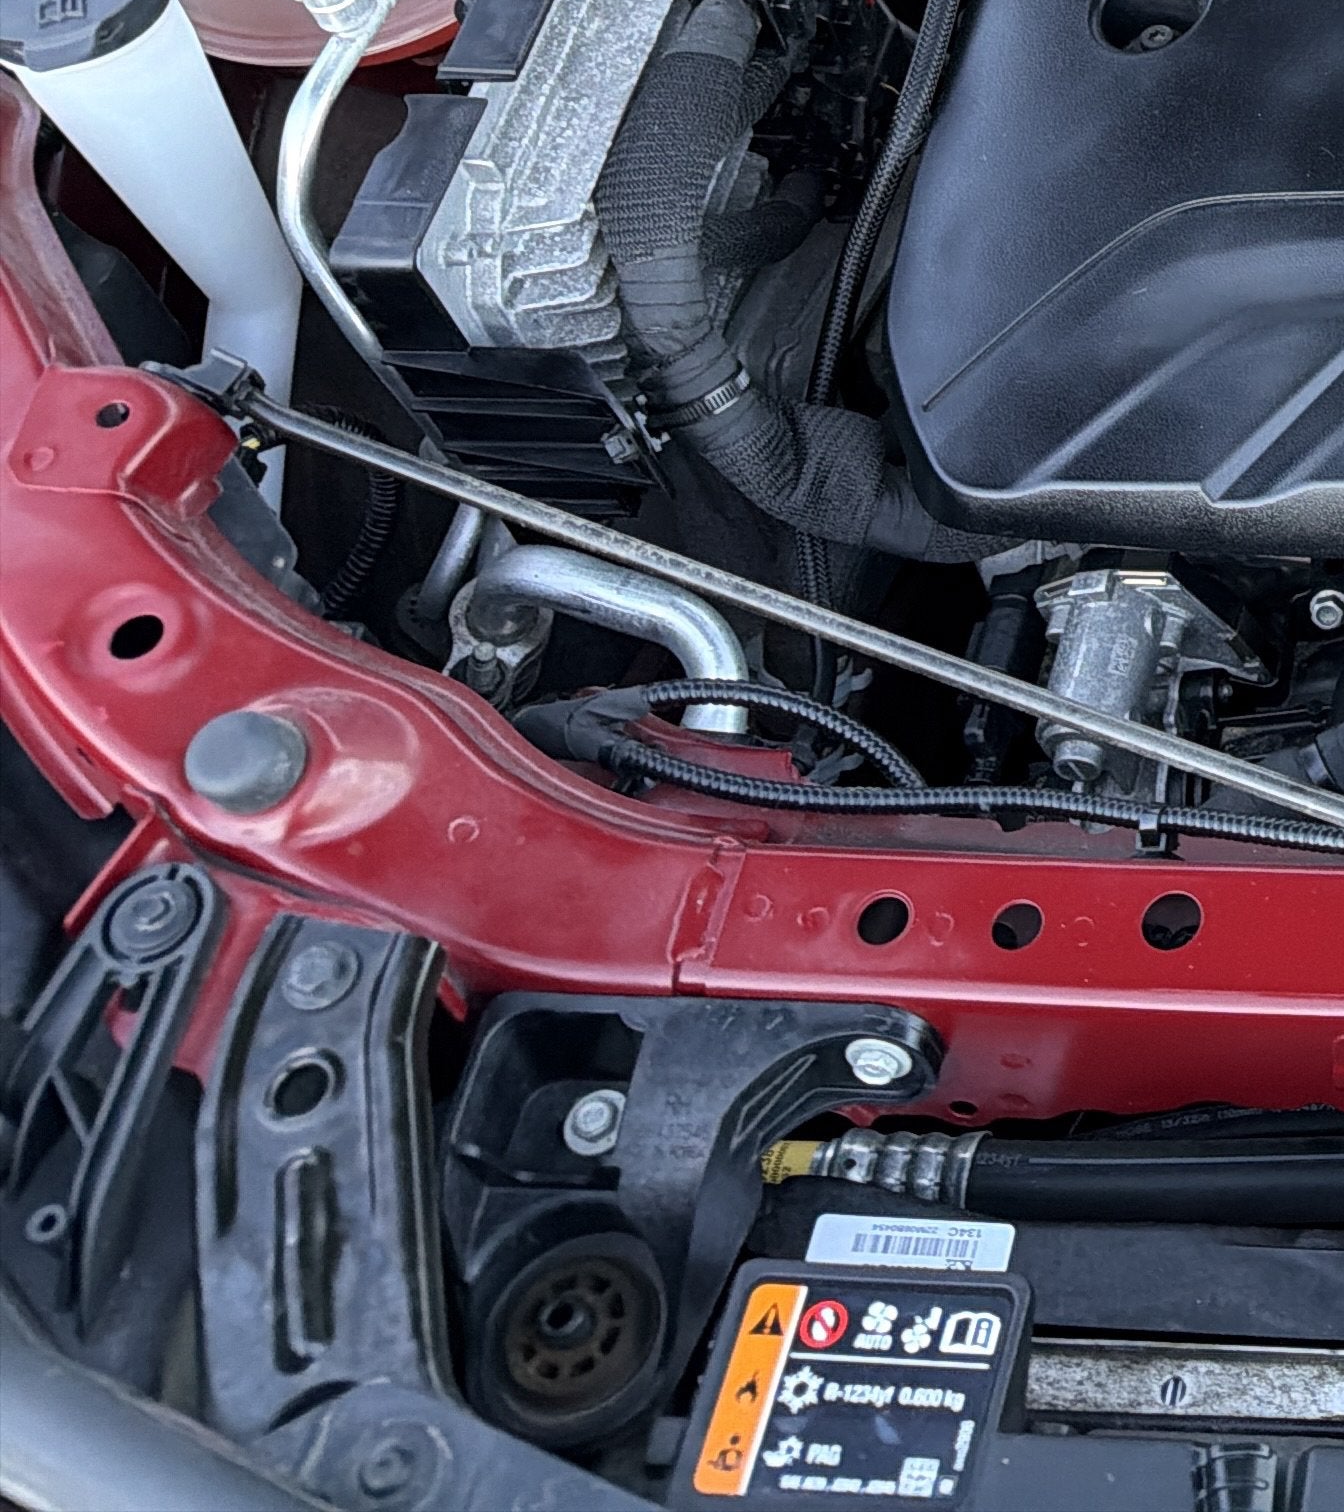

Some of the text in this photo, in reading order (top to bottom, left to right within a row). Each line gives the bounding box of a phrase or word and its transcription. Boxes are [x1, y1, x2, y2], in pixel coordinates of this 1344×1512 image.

[948, 1227, 983, 1239] 134C
[853, 1334, 892, 1351] AUTO
[823, 1382, 895, 1408] R-1234yf
[943, 1389, 966, 1413] kg
[806, 1443, 842, 1467] PAG
